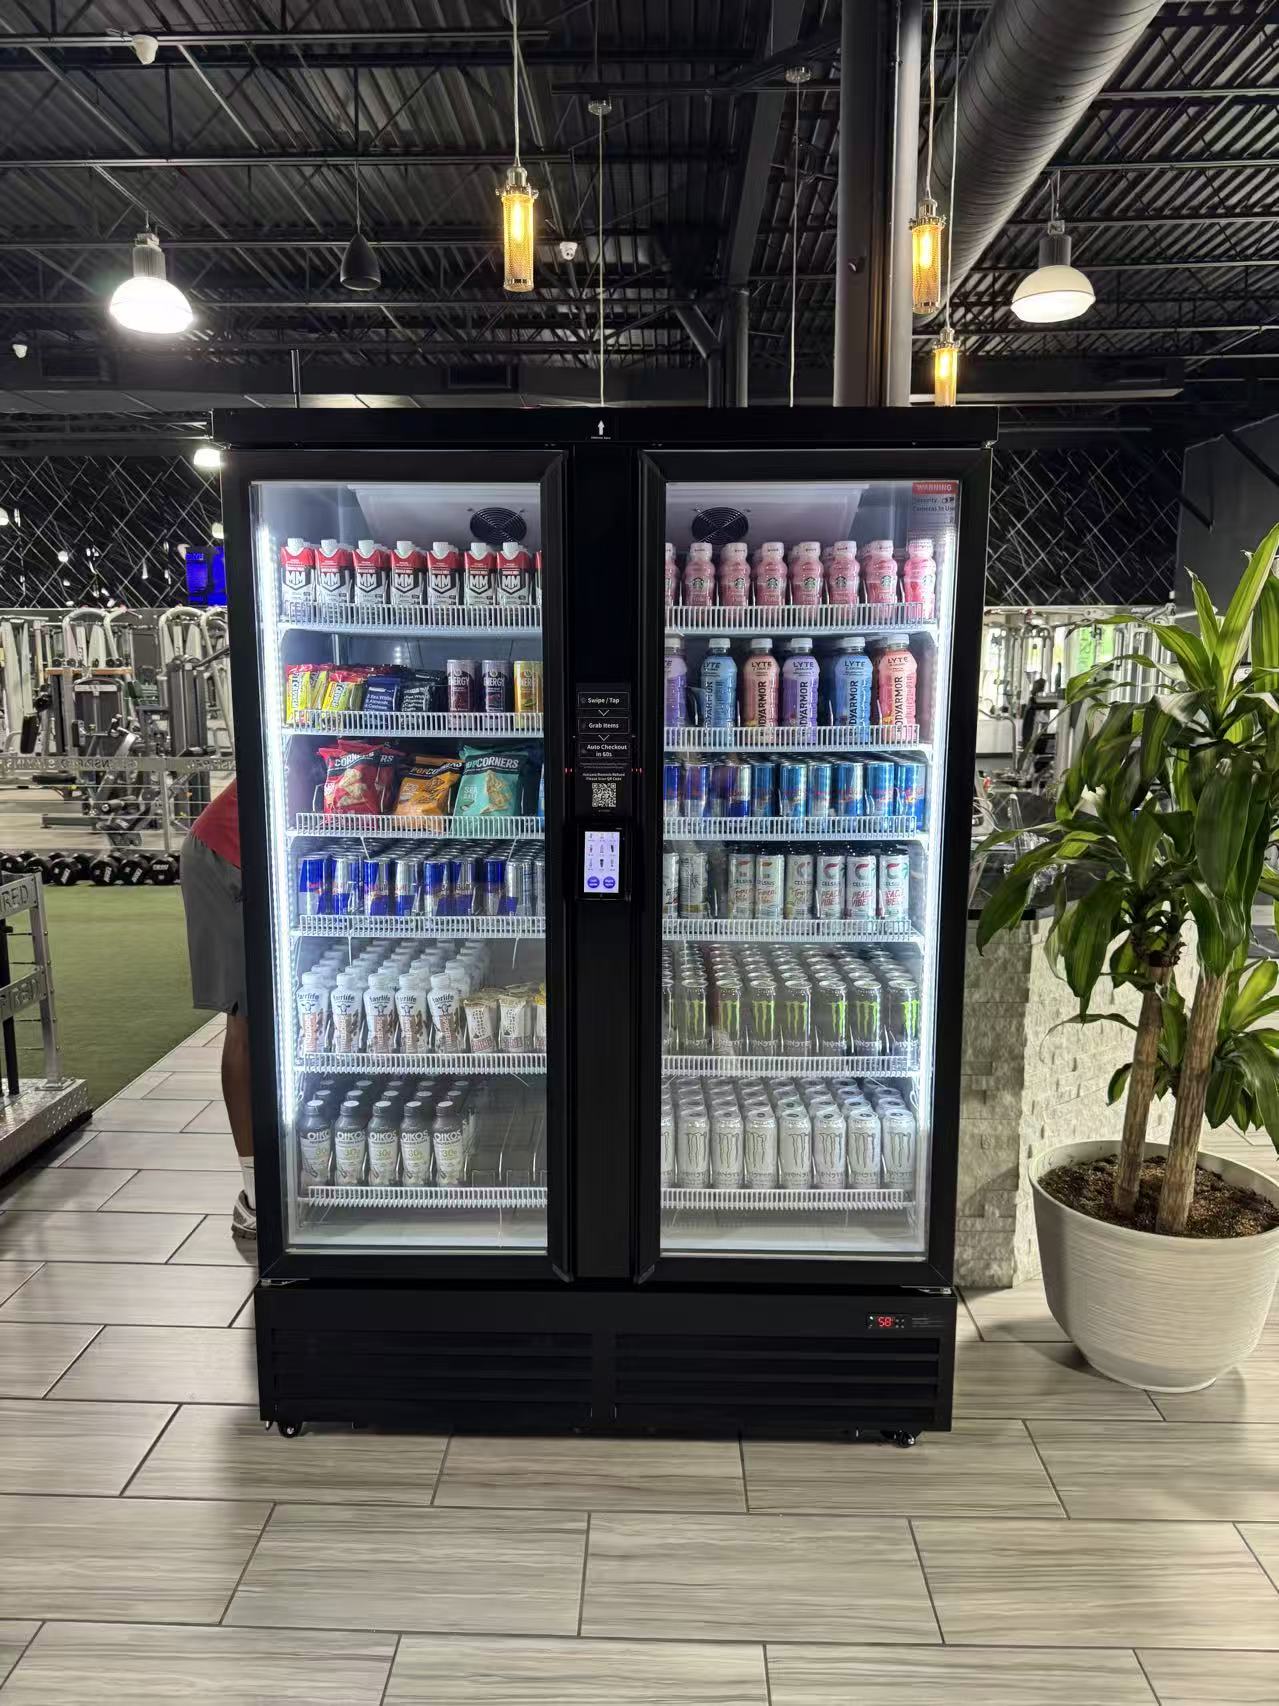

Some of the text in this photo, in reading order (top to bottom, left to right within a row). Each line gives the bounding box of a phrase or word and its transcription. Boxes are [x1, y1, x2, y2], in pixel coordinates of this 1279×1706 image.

[758, 681, 767, 728] DYARMOR
[799, 681, 808, 728] DYARMOR
[849, 680, 858, 728] DYARMOR
[894, 676, 904, 726] ODYARMOR
[369, 1130, 397, 1141] OIKOS
[433, 1129, 462, 1141] OIKOS
[878, 1316, 892, 1327] 58
